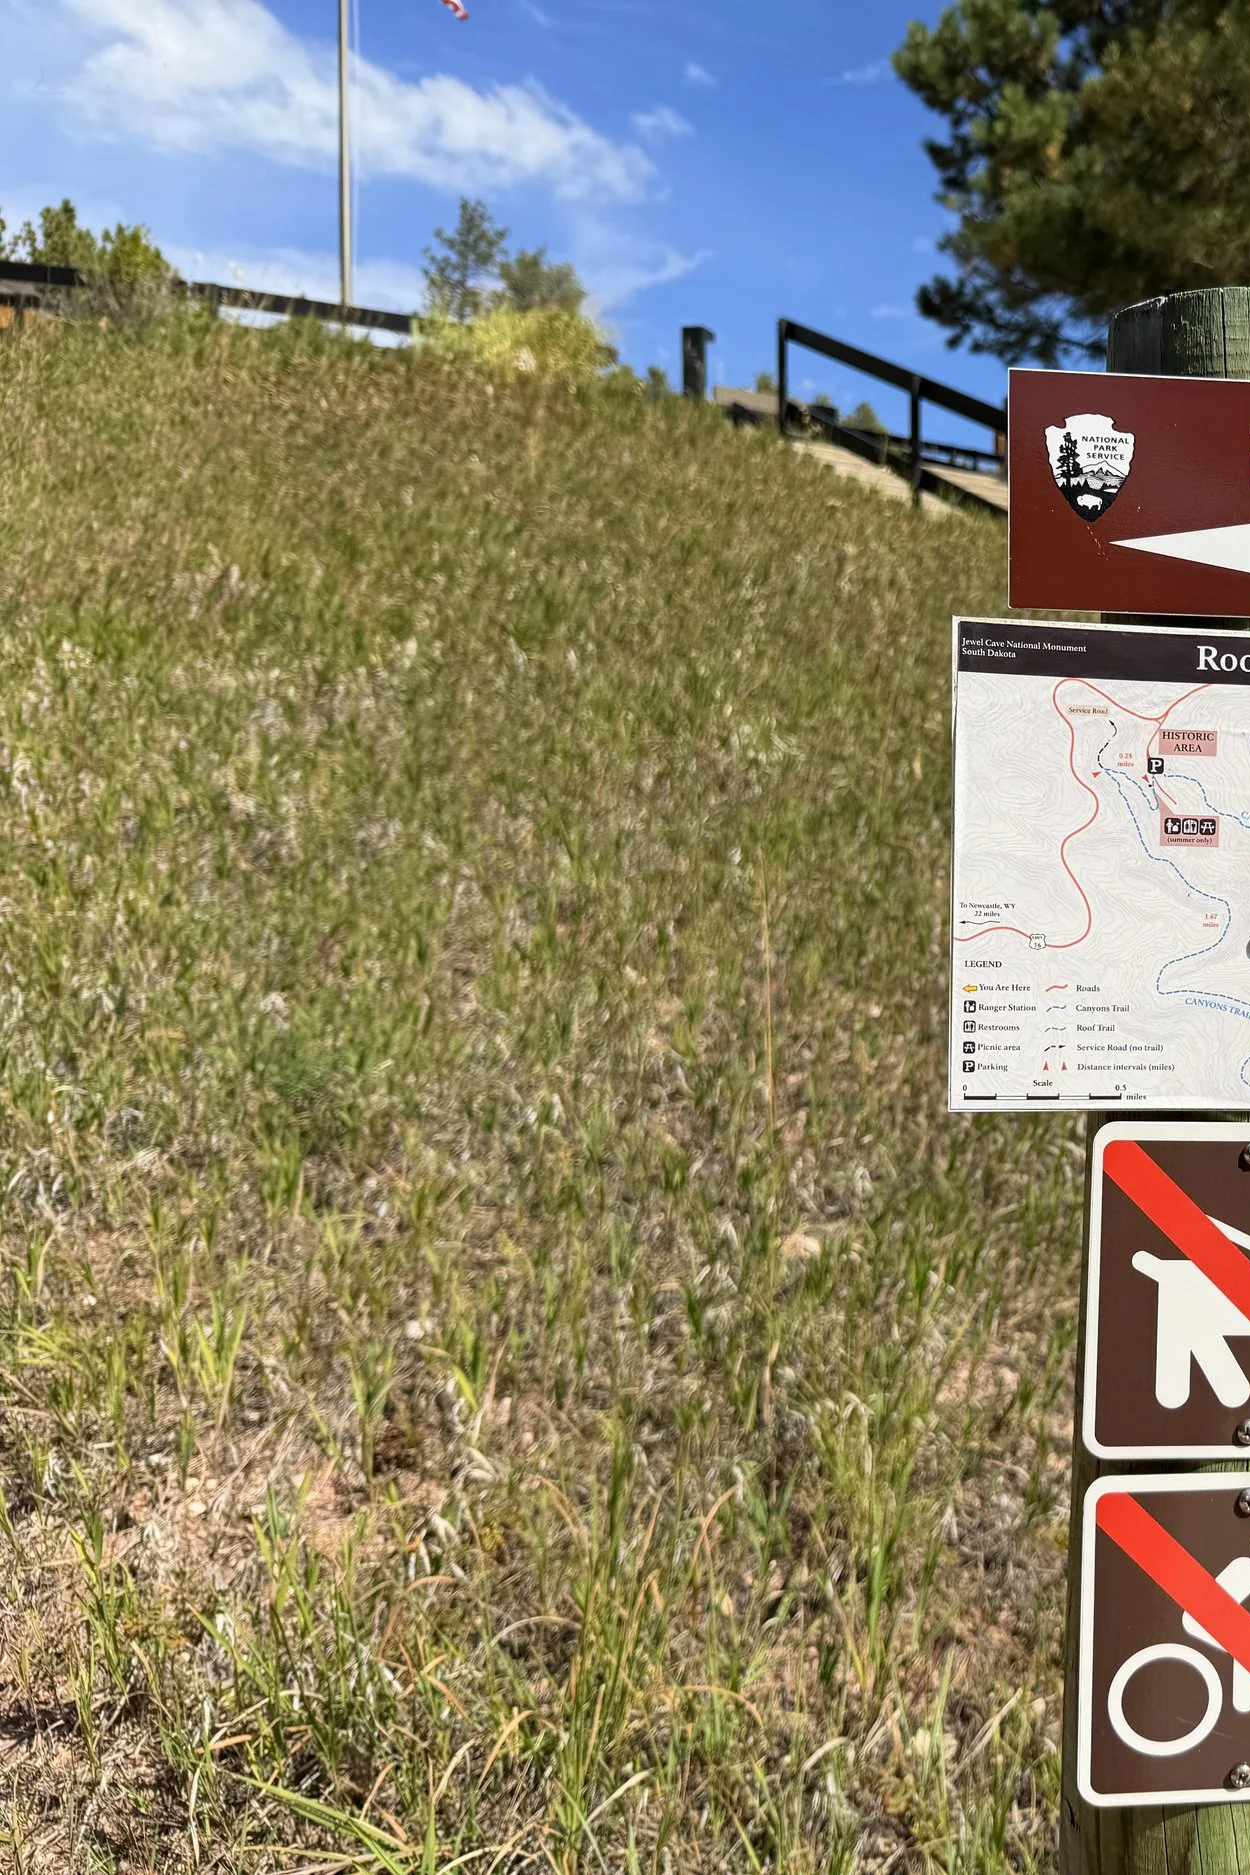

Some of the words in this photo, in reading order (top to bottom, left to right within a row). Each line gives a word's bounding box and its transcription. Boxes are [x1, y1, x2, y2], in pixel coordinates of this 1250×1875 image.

[1081, 436, 1130, 444] NATIONAL
[1086, 452, 1125, 460] SERVICE
[961, 637, 984, 647] Jewel
[985, 639, 1005, 648] Cave
[1006, 640, 1041, 650] National
[1042, 642, 1087, 653] Monument
[961, 647, 986, 657] South
[987, 648, 1017, 658] Dakota
[1068, 706, 1091, 715] Service
[1092, 707, 1109, 715] Road
[1161, 731, 1215, 742] HISTORIC
[1173, 743, 1203, 753] AREA
[1196, 836, 1213, 845] only)
[978, 1004, 1007, 1013] Ranger
[1008, 1004, 1036, 1012] Station
[1075, 1004, 1110, 1014] Canyons
[1184, 998, 1228, 1012] CANYONS
[1076, 1044, 1106, 1052] Service
[1107, 1044, 1128, 1052] Road
[1129, 1044, 1143, 1053] (no
[1144, 1044, 1164, 1053] trail)
[977, 1063, 1008, 1072] Parking
[1077, 1063, 1112, 1071] Distance
[1113, 1063, 1147, 1071] intervals
[1148, 1063, 1176, 1072] (miles)
